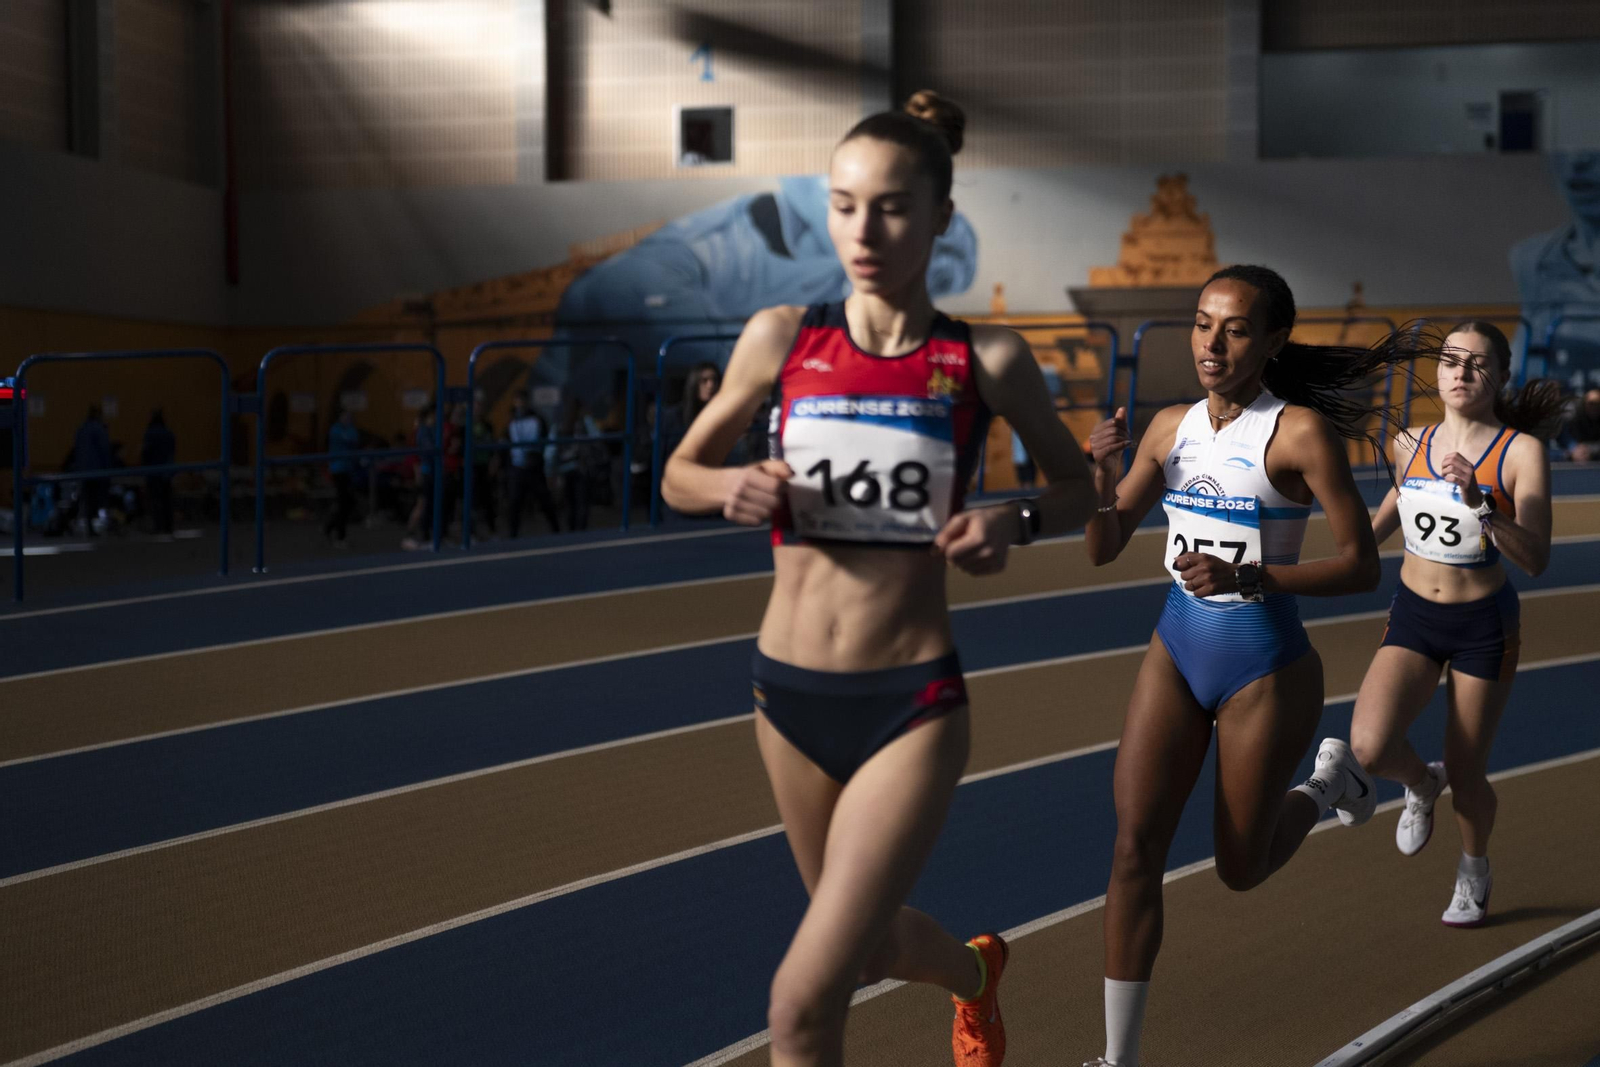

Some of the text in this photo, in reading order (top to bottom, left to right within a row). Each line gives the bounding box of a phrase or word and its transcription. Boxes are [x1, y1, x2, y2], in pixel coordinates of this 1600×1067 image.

[689, 43, 715, 81] 1
[794, 400, 947, 418] OURENSE 2026
[806, 459, 929, 511] 168
[1180, 475, 1200, 492] CIEDAD
[1405, 479, 1455, 493] OUREE
[1165, 493, 1256, 511] OURENSE 2026
[1414, 512, 1462, 547] 93
